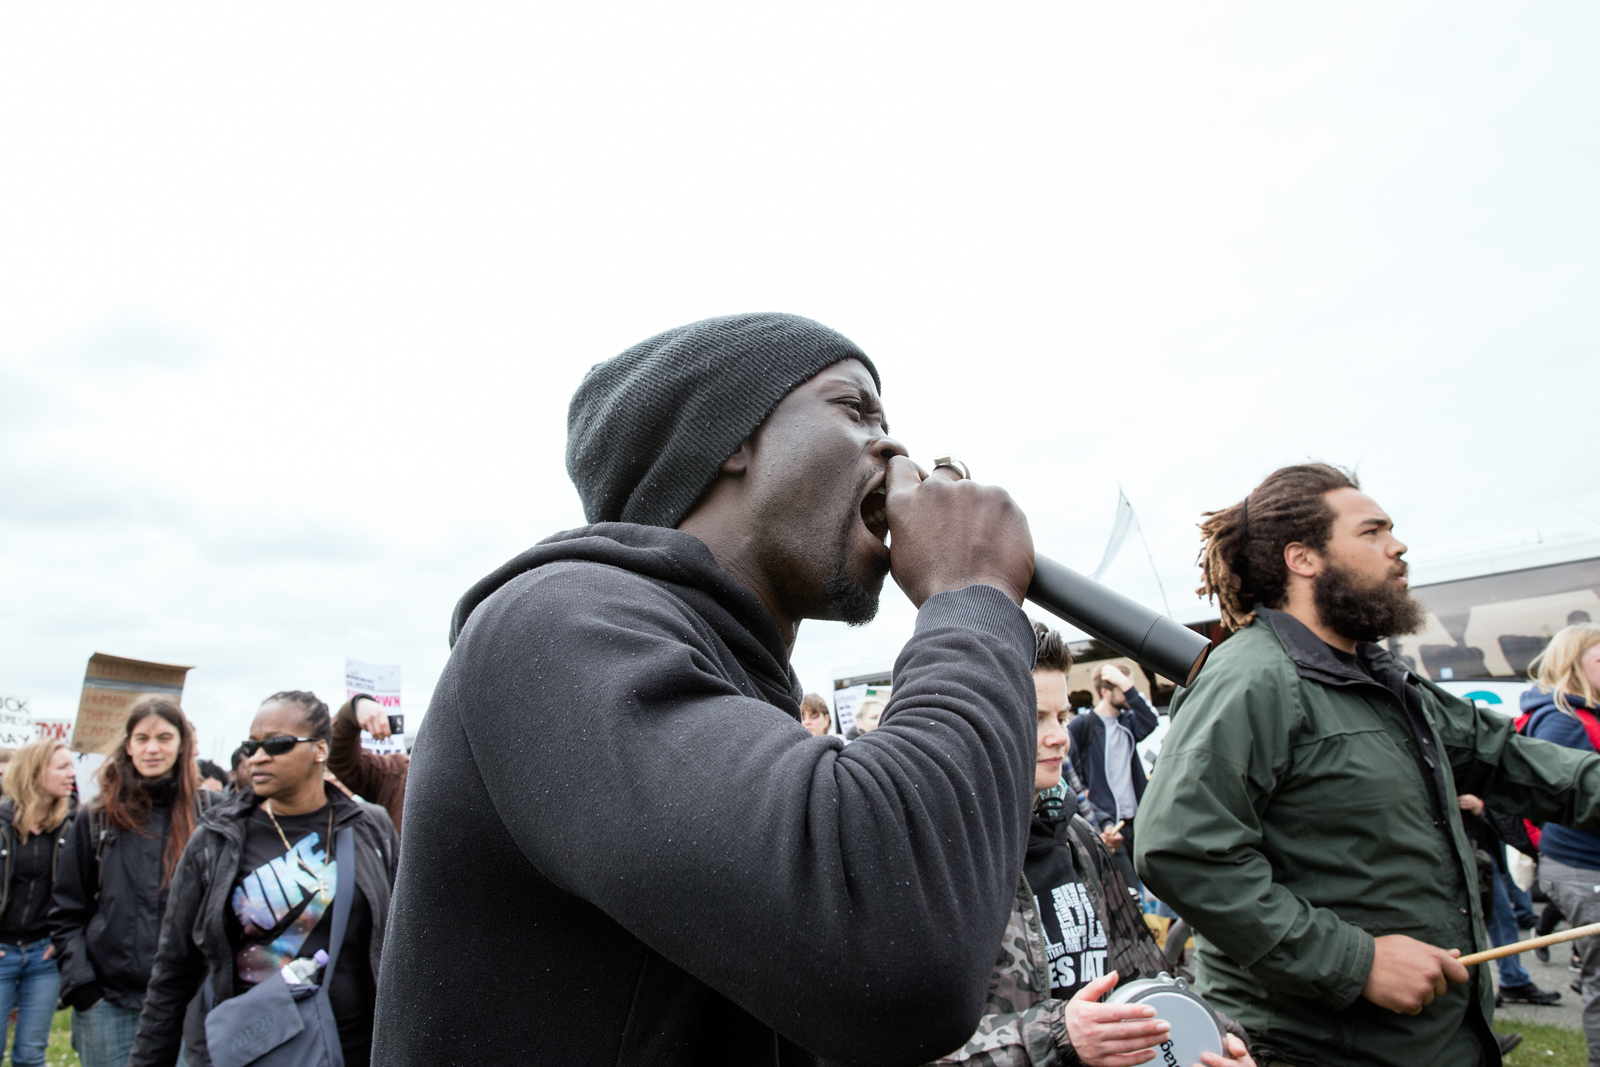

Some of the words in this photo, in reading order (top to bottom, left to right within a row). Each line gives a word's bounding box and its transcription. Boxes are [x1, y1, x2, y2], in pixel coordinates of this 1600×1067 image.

[85, 691, 127, 708] HUMAN
[83, 708, 113, 722] THEY
[232, 831, 336, 931] NIKE
